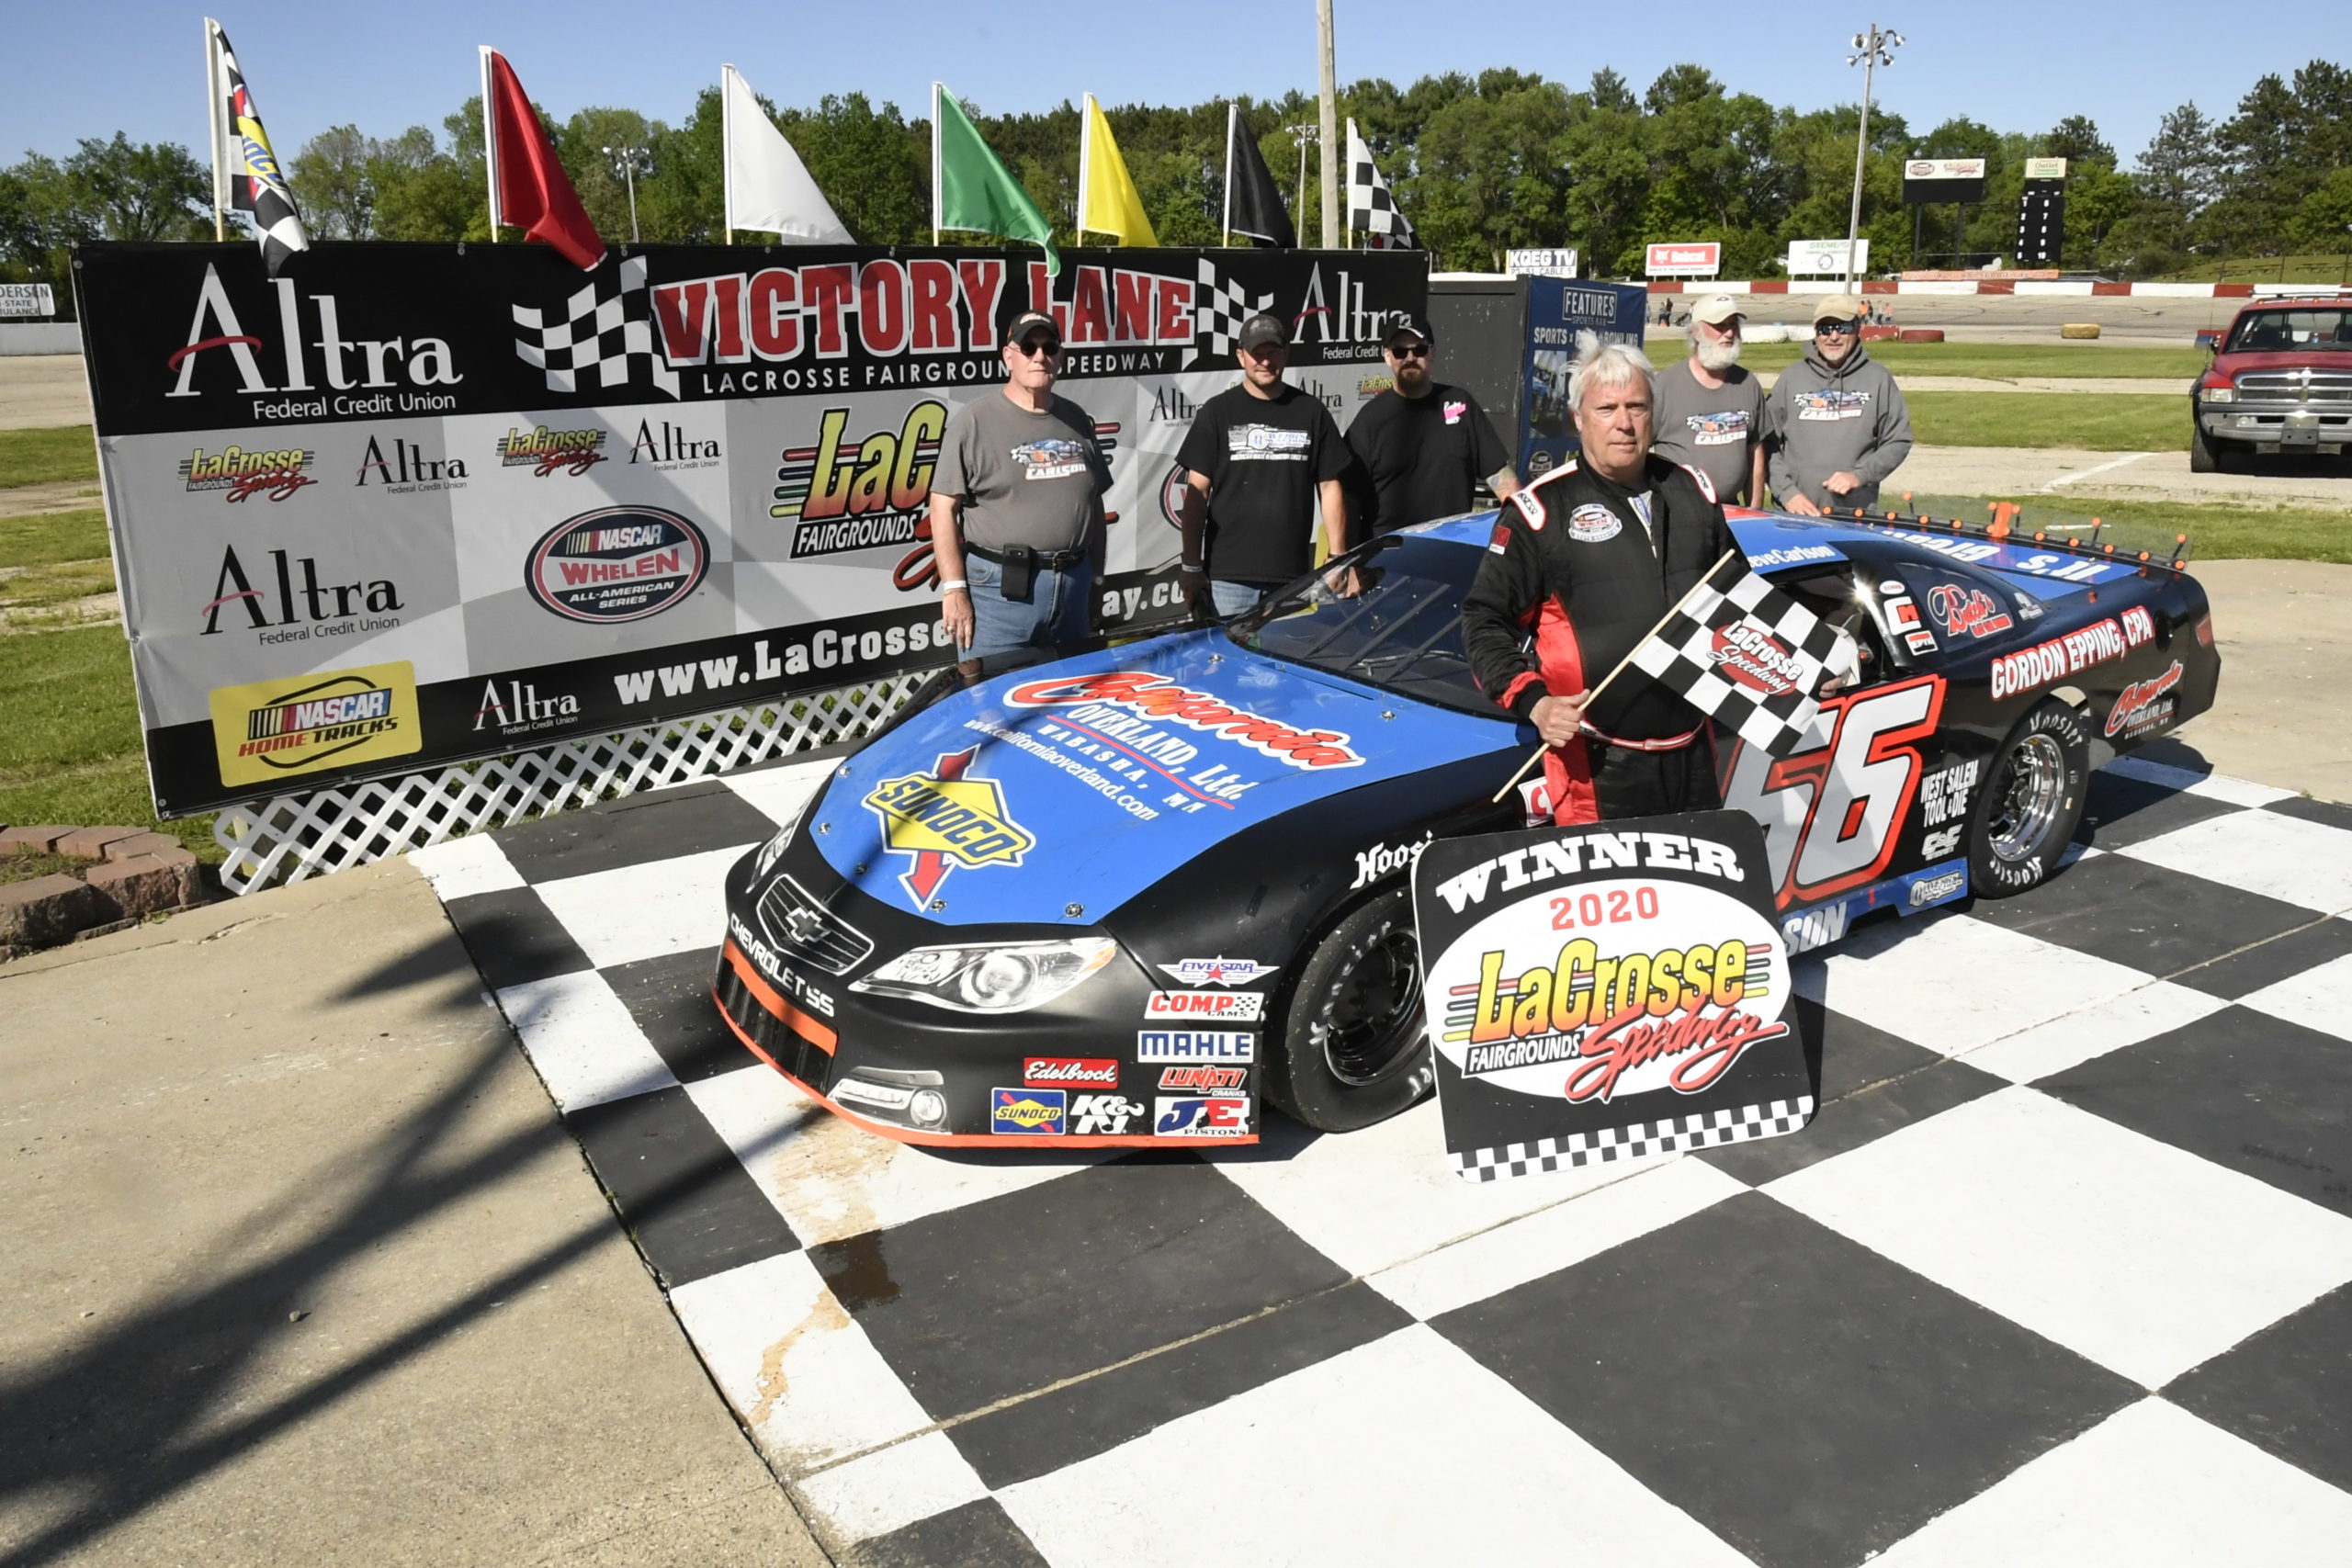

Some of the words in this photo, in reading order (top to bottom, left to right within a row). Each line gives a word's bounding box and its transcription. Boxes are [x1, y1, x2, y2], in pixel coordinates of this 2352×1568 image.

[1510, 251, 1552, 266] KQEG
[1554, 250, 1576, 265] TV
[650, 259, 1007, 367] VICTORY
[1027, 261, 1195, 348] LANE
[1565, 291, 1615, 318] FEATURES
[164, 262, 463, 397] Altra
[1533, 327, 1567, 345] SPORTS
[1323, 346, 1352, 359] Federal
[1355, 344, 1379, 357] Credit
[703, 367, 850, 394] LACROSSE
[865, 357, 1012, 386] FAIRGROUN
[1057, 352, 1164, 375] PEEDWAY
[254, 398, 327, 420] Federal
[334, 395, 393, 415] Credit
[399, 392, 456, 412] Union
[1148, 385, 1197, 422] Altr
[506, 425, 599, 457] LaCrosse
[628, 417, 722, 464] Altra
[188, 446, 304, 479] LaCrosse
[355, 434, 469, 487] Altra
[653, 463, 678, 471] Federal
[679, 461, 699, 469] Credit
[700, 459, 719, 468] Union
[1026, 464, 1087, 479] CARLSON
[387, 486, 416, 495] Federal
[418, 483, 443, 492] Credit
[444, 481, 467, 491] Union
[597, 525, 663, 551] NASCAR
[797, 514, 915, 553] FAIRGROUNDS
[560, 548, 680, 586] WHELEN
[199, 544, 405, 636] Altra
[569, 581, 675, 603] ALL-AMERICAN
[598, 595, 648, 609] SERIES
[259, 627, 310, 645] Federal
[314, 623, 356, 639] Credit
[359, 616, 401, 632] Union
[1722, 620, 1804, 681] LaCrosse
[1991, 645, 2065, 701] GORDON
[2068, 624, 2126, 671] EPPING,
[2126, 606, 2155, 649] CPA
[1706, 645, 1791, 695] Speedway
[293, 691, 387, 729] NASCAR
[472, 679, 581, 731] Altra
[238, 733, 308, 758] HOME
[313, 716, 399, 744] TRACKS
[503, 723, 530, 735] Federal
[532, 719, 553, 730] Credit
[556, 716, 578, 726] Union
[964, 719, 1159, 821] www.californiaoverland.com
[1036, 723, 1148, 790] WABASHA,
[1162, 792, 1208, 813] MN
[1067, 703, 1199, 775] OVERLAND,
[1188, 763, 1259, 801] Ltd.
[1921, 770, 1948, 804] WEST
[1947, 759, 1979, 795] SALEM
[876, 780, 1019, 859] SUNOCO
[1924, 795, 1951, 828] TOOL
[1951, 788, 1969, 818] DIE
[1350, 829, 1432, 889] Hoos
[1435, 831, 1745, 914] WINNER
[1549, 886, 1659, 931] 2020
[730, 912, 806, 997] CHEVROLET
[806, 984, 835, 1017] SS
[1181, 962, 1216, 972] FIVE
[1219, 962, 1254, 973] STAR
[1151, 995, 1235, 1012] COMP
[1469, 937, 1747, 1043] LaCrosse
[1141, 1033, 1250, 1056] MAHLE
[1469, 1033, 1580, 1073] FAIRGROUNDS
[1565, 992, 1788, 1102] Speedway
[1024, 1061, 1117, 1084] Edelbrock
[1161, 1066, 1245, 1089] LUNATI
[1212, 1089, 1247, 1098] CRANKS
[998, 1108, 1059, 1119] SUNOCO
[1157, 1100, 1244, 1133] JE
[1183, 1128, 1247, 1136] PISTONS
